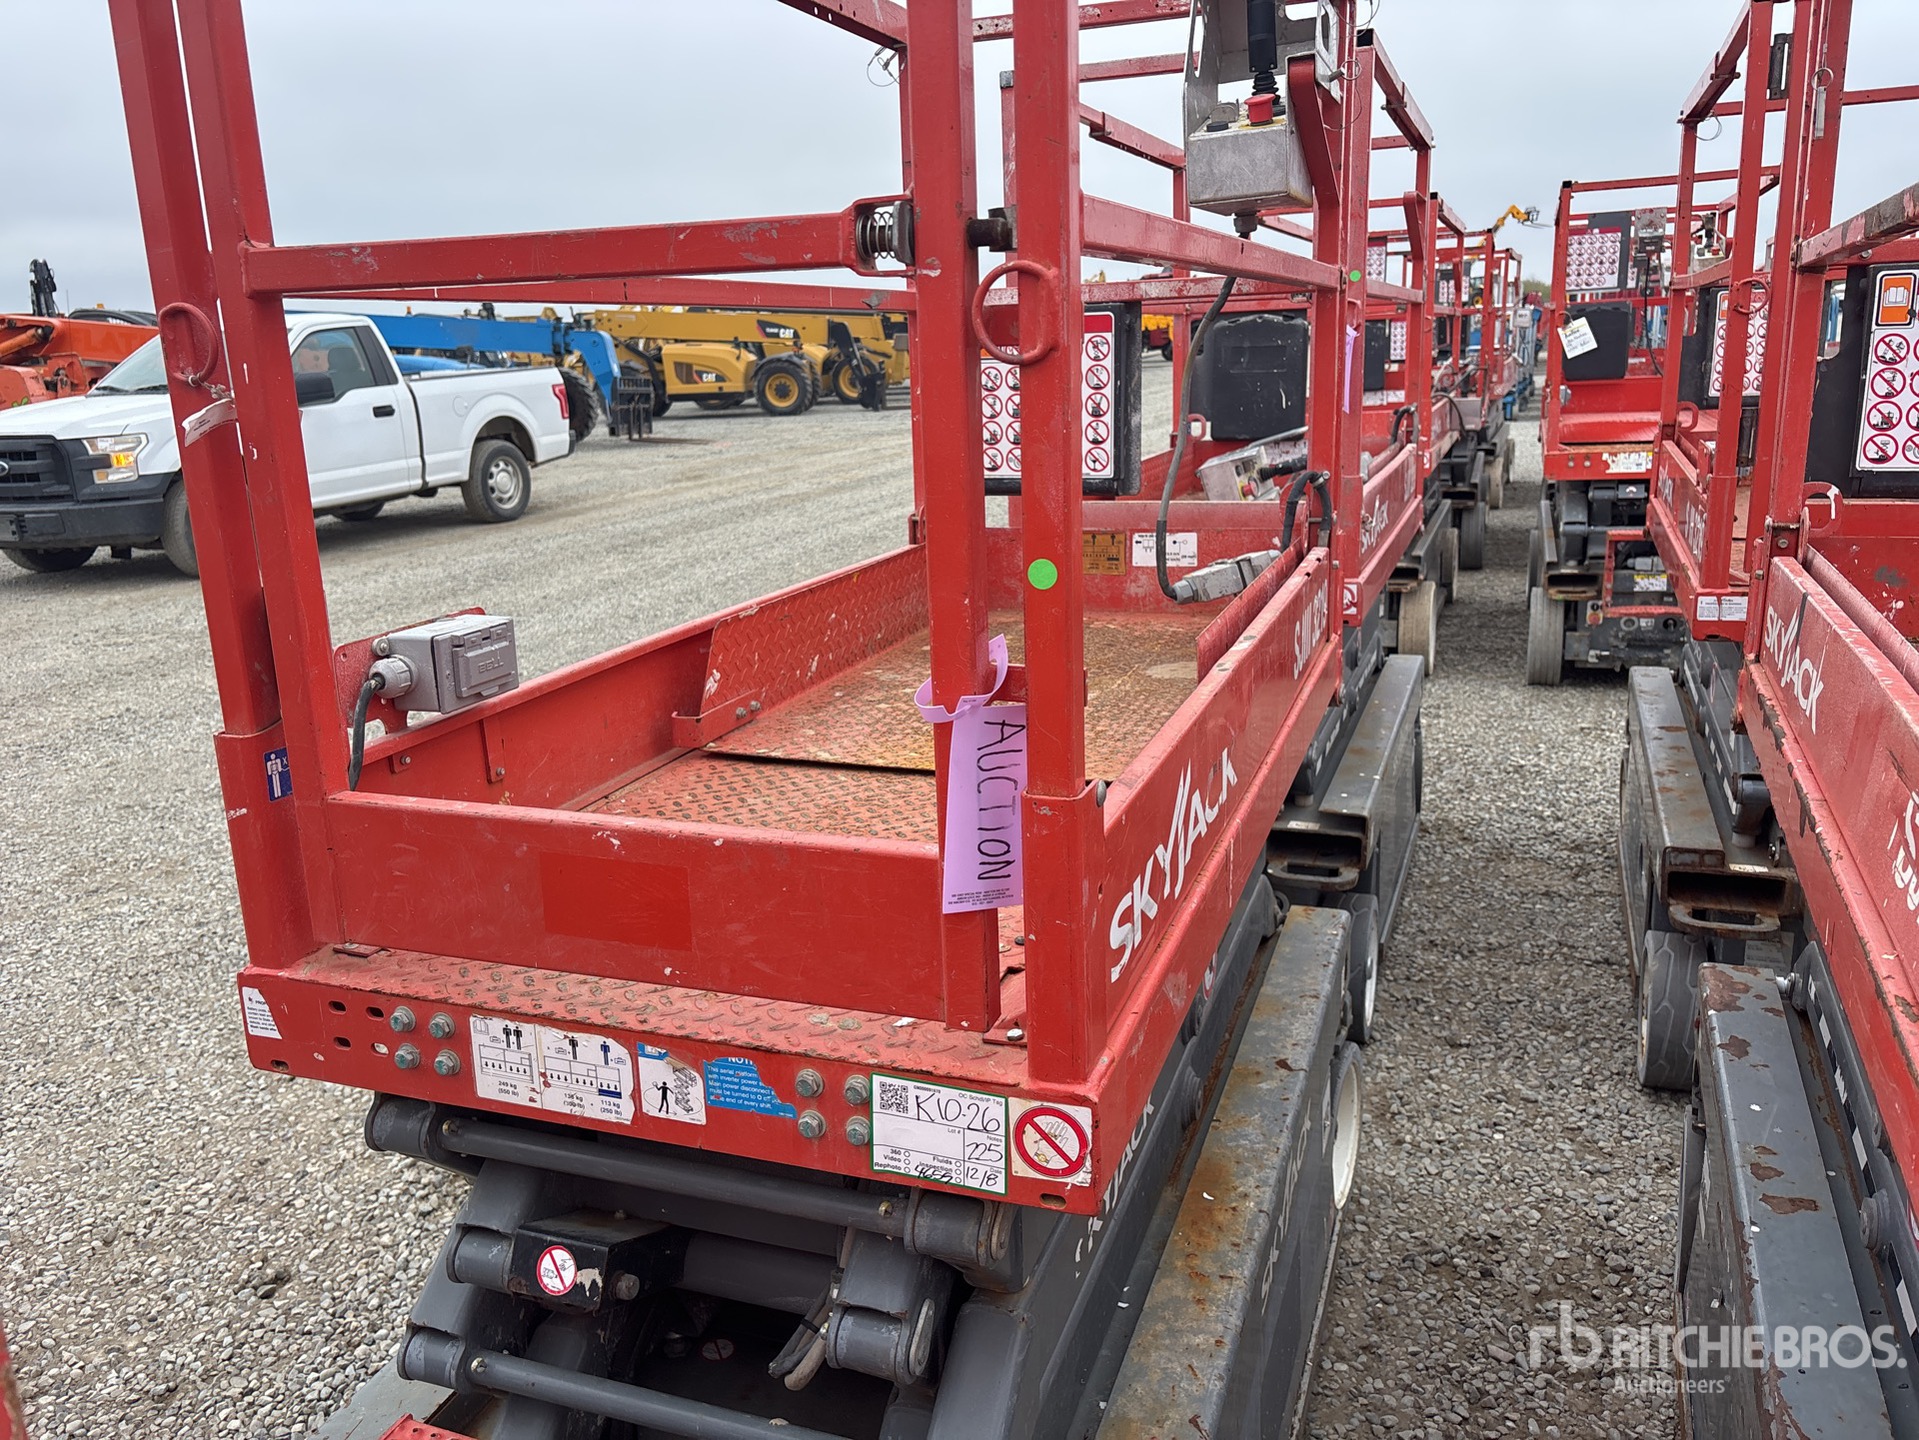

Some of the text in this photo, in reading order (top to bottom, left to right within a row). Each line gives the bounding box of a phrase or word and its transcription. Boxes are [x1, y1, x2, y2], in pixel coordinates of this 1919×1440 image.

[779, 328, 795, 338] CAT
[702, 372, 716, 382] CAT
[1764, 605, 1825, 735] SKYJACK
[976, 719, 1026, 880] AUCTION
[1109, 747, 1238, 984] SKYJACK
[498, 1080, 517, 1090] 249 kg
[708, 1080, 721, 1088] Main
[722, 1083, 739, 1091] power
[741, 1084, 769, 1094] disconnect
[741, 1078, 758, 1086] power
[498, 1087, 510, 1095] (550
[731, 1091, 749, 1099] turned
[992, 1098, 1003, 1107] Tag
[600, 1107, 613, 1115] (250
[915, 1093, 1000, 1132] K10-26
[986, 1135, 1003, 1143] Notes
[966, 1142, 1003, 1162] 225
[883, 1154, 901, 1163] Video
[932, 1156, 953, 1165] Fluids
[874, 1162, 902, 1171] Rephoto
[920, 1161, 953, 1173] Inspection
[990, 1167, 1002, 1175] Date
[966, 1166, 999, 1188] 12/8
